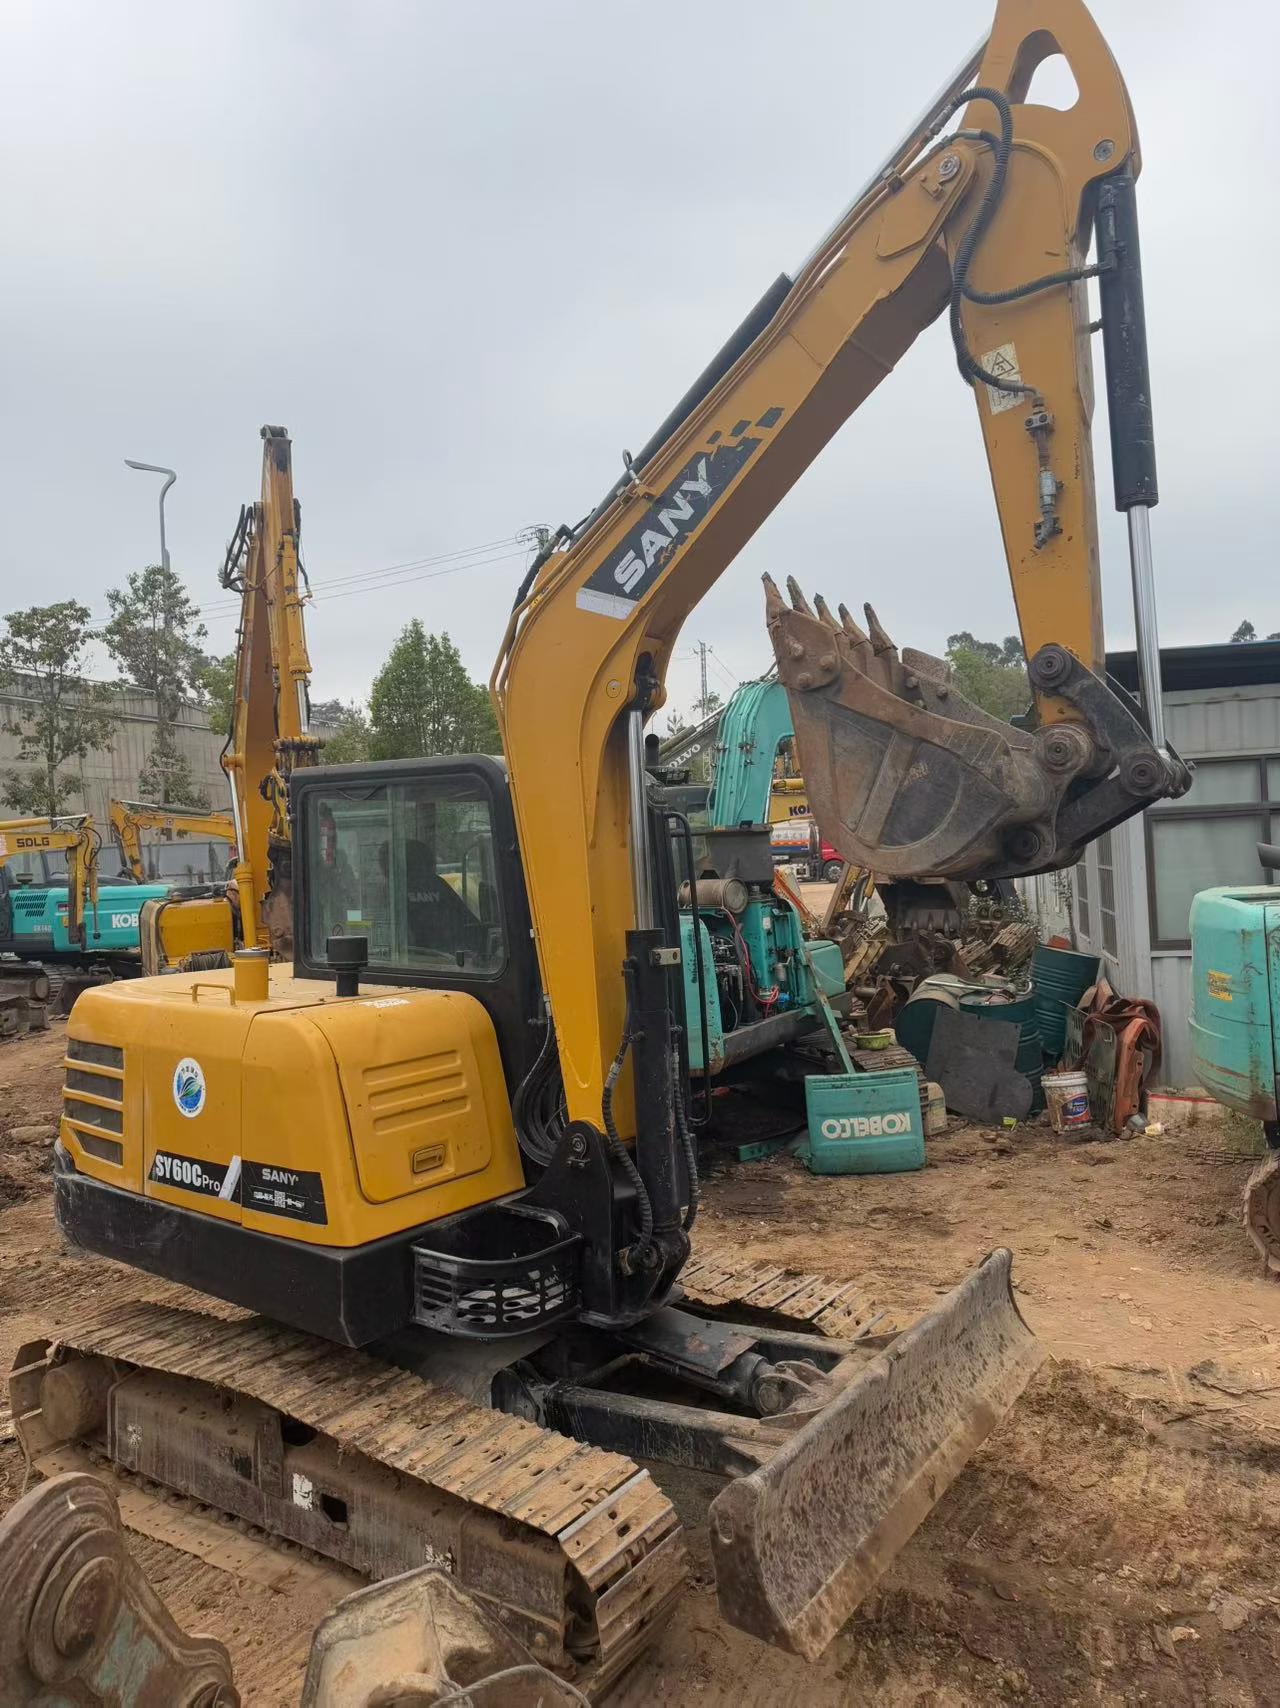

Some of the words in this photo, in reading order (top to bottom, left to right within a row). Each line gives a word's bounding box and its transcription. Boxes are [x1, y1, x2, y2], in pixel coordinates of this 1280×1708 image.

[613, 457, 712, 594] SANY
[16, 836, 50, 848] SDLG
[408, 891, 440, 903] SANY
[821, 1112, 911, 1139] KOBELCO
[262, 1168, 297, 1186] SANY
